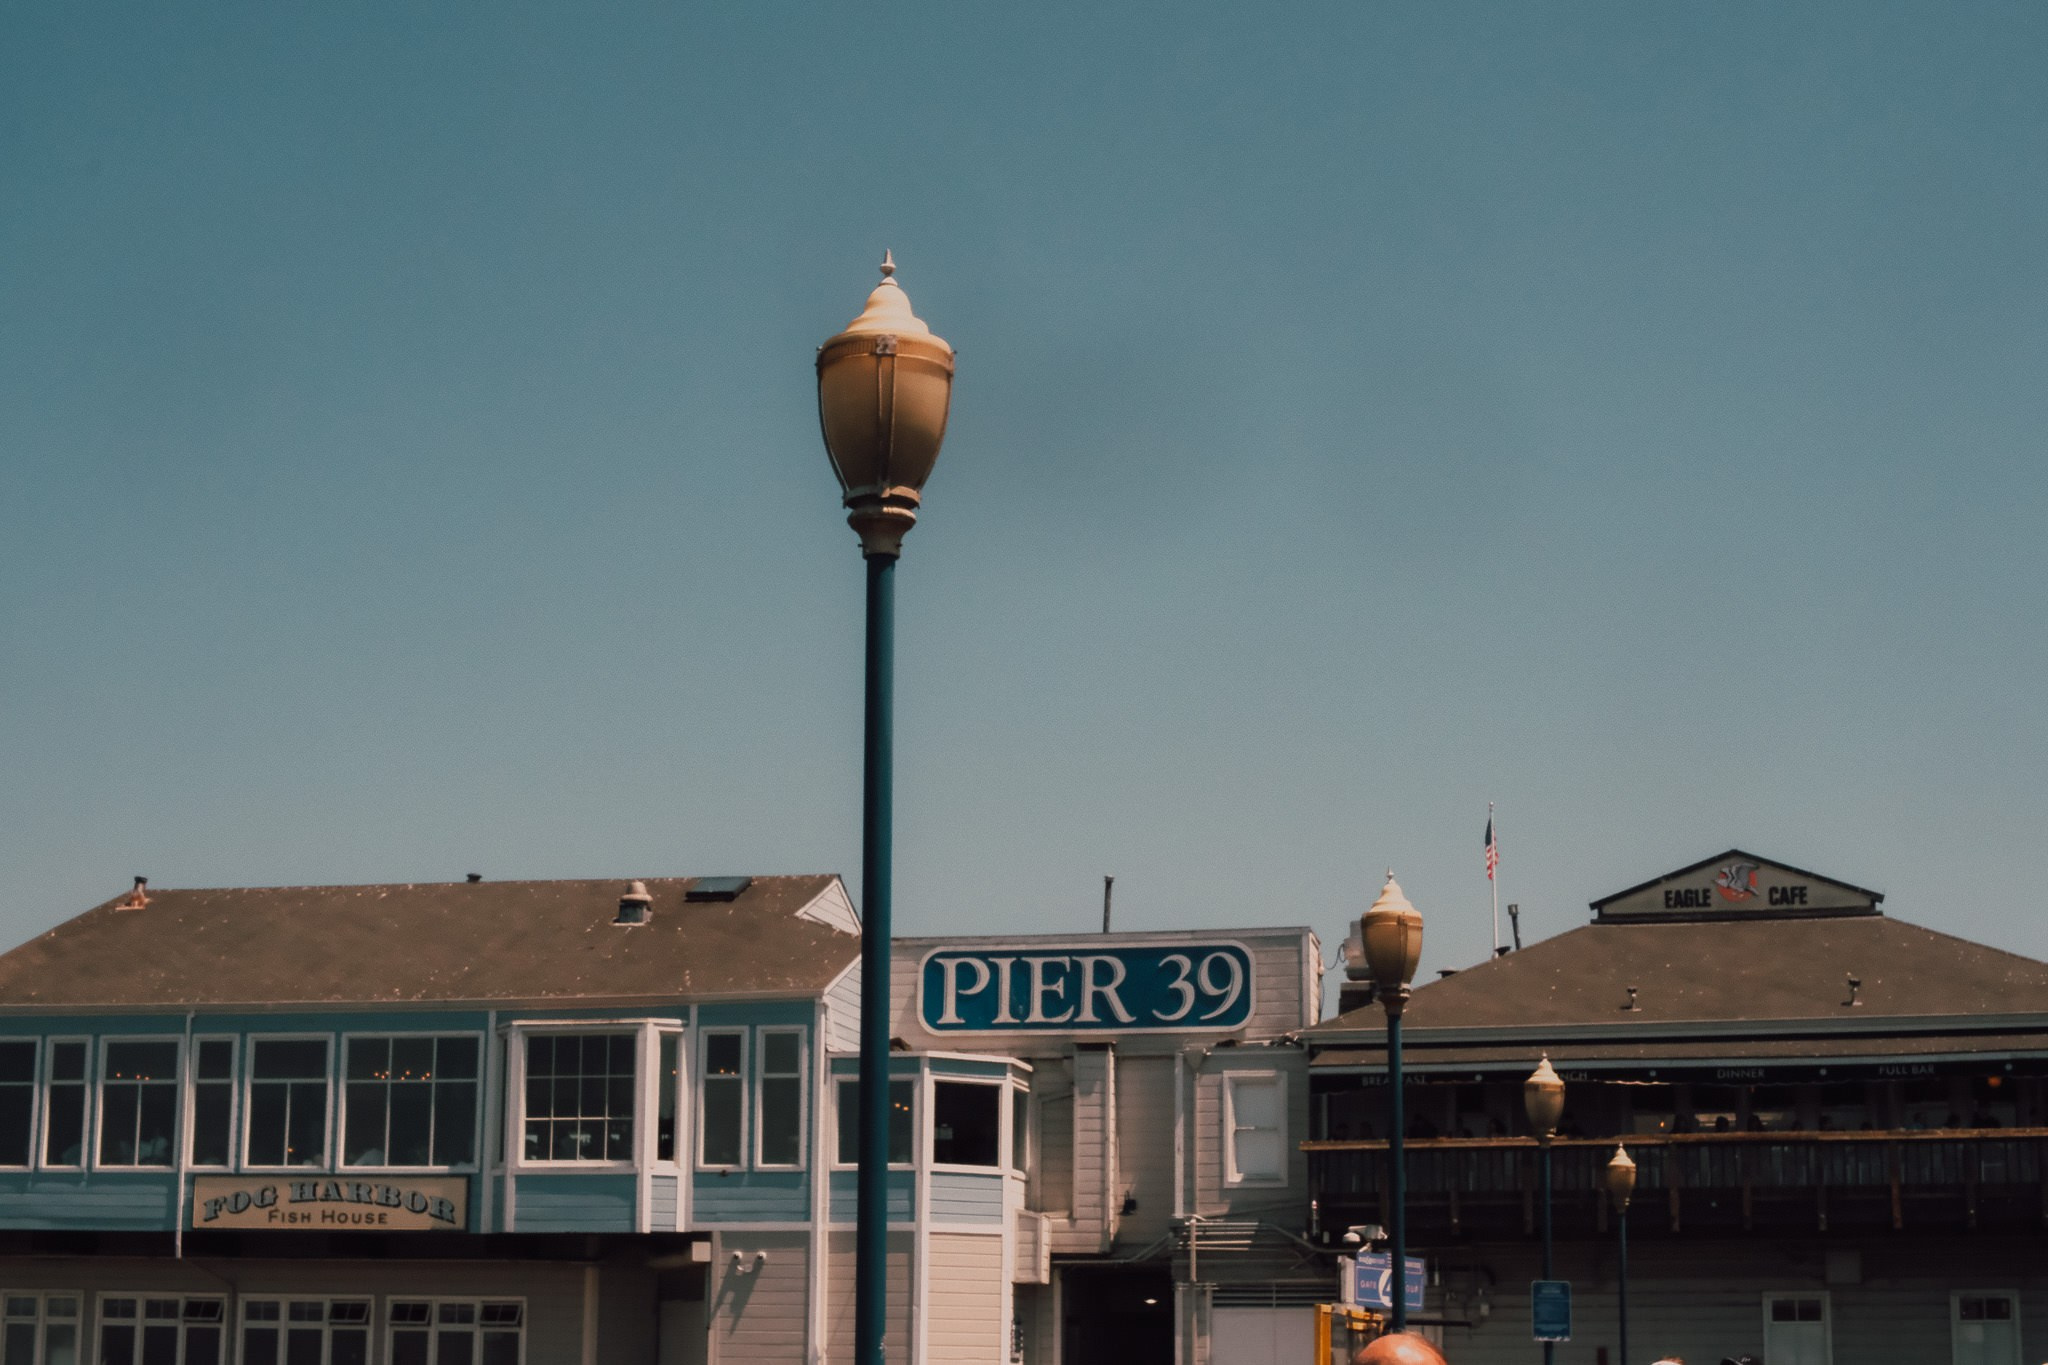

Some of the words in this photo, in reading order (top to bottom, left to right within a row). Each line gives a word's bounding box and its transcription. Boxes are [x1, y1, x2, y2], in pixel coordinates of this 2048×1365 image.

[1664, 889, 1711, 908] EAGLE
[1769, 886, 1807, 905] CAFE
[934, 956, 1137, 1024] PIER
[1152, 952, 1243, 1021] 39
[1361, 1075, 1425, 1087] BREAAST
[1717, 1068, 1765, 1080] DINNER
[1878, 1065, 1908, 1076] FULL
[1911, 1063, 1936, 1075] BAR
[203, 1185, 279, 1222] FOG
[288, 1181, 456, 1224] HARBOR
[268, 1209, 311, 1224] FISH
[321, 1209, 388, 1224] HOUSE
